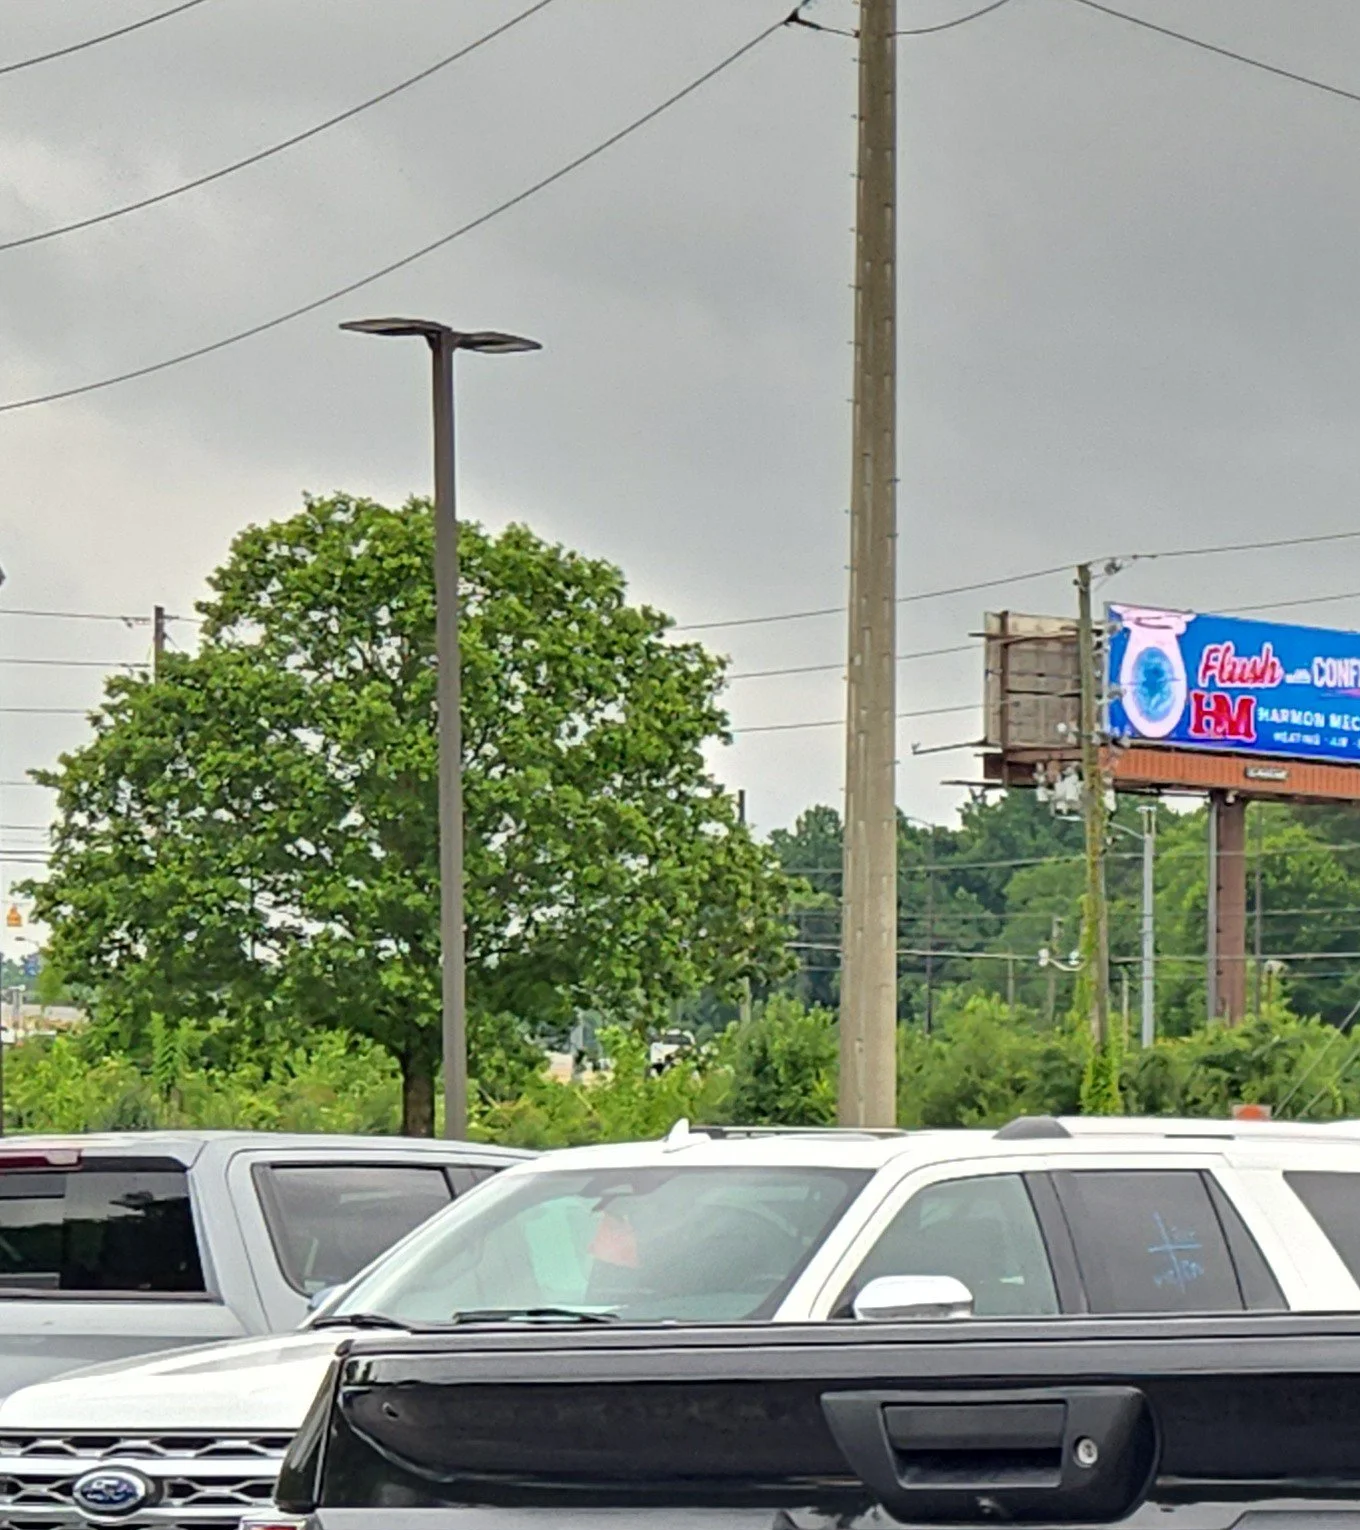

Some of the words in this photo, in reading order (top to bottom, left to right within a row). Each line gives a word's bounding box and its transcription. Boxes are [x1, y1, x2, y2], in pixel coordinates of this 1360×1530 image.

[1198, 641, 1284, 688] Flush
[1190, 690, 1257, 742] HM
[1258, 706, 1325, 728] HARMON
